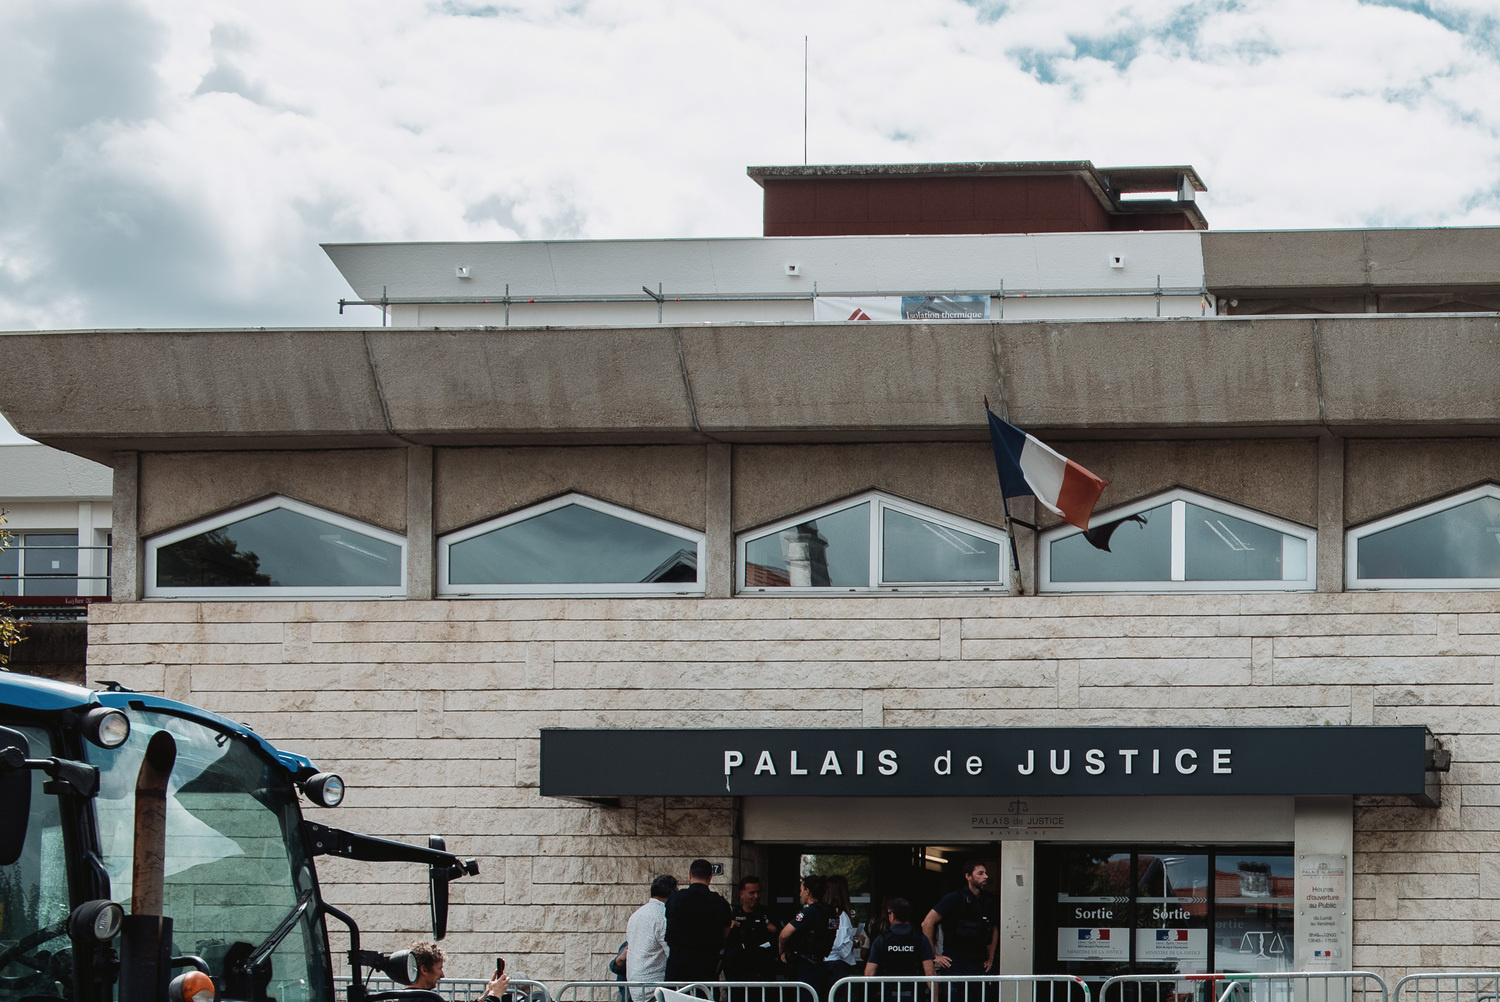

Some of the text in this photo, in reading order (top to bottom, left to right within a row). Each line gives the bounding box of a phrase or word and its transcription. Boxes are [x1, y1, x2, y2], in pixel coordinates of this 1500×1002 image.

[905, 311, 982, 319] Isolation thermique
[724, 749, 1232, 776] PALAIS de JUSTICE
[972, 817, 1064, 825] PALAIS de JUSTICE
[1075, 908, 1113, 919] Sortie
[1152, 908, 1191, 920] Sortie
